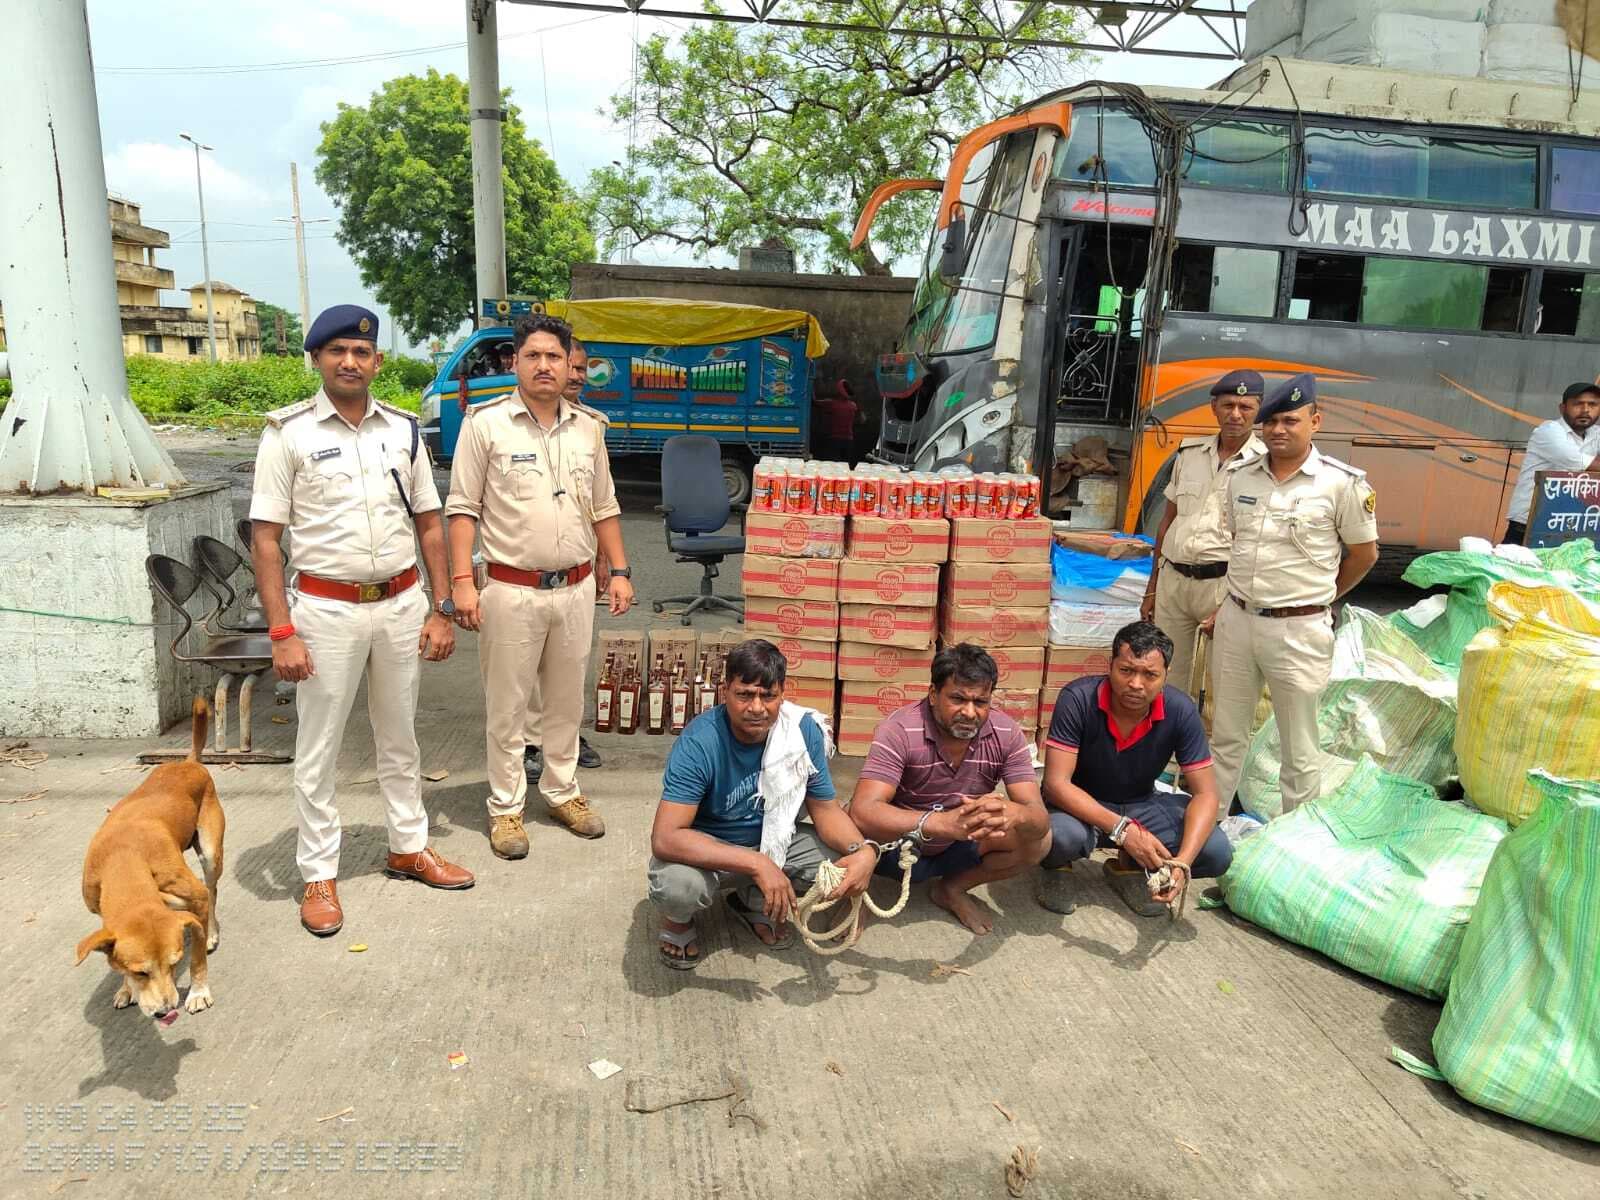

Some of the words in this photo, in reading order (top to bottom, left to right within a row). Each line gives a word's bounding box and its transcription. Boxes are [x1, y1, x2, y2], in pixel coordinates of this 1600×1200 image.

[1298, 203, 1412, 252] MAA
[1428, 212, 1595, 264] LAXMI
[631, 356, 688, 390] PRINCE
